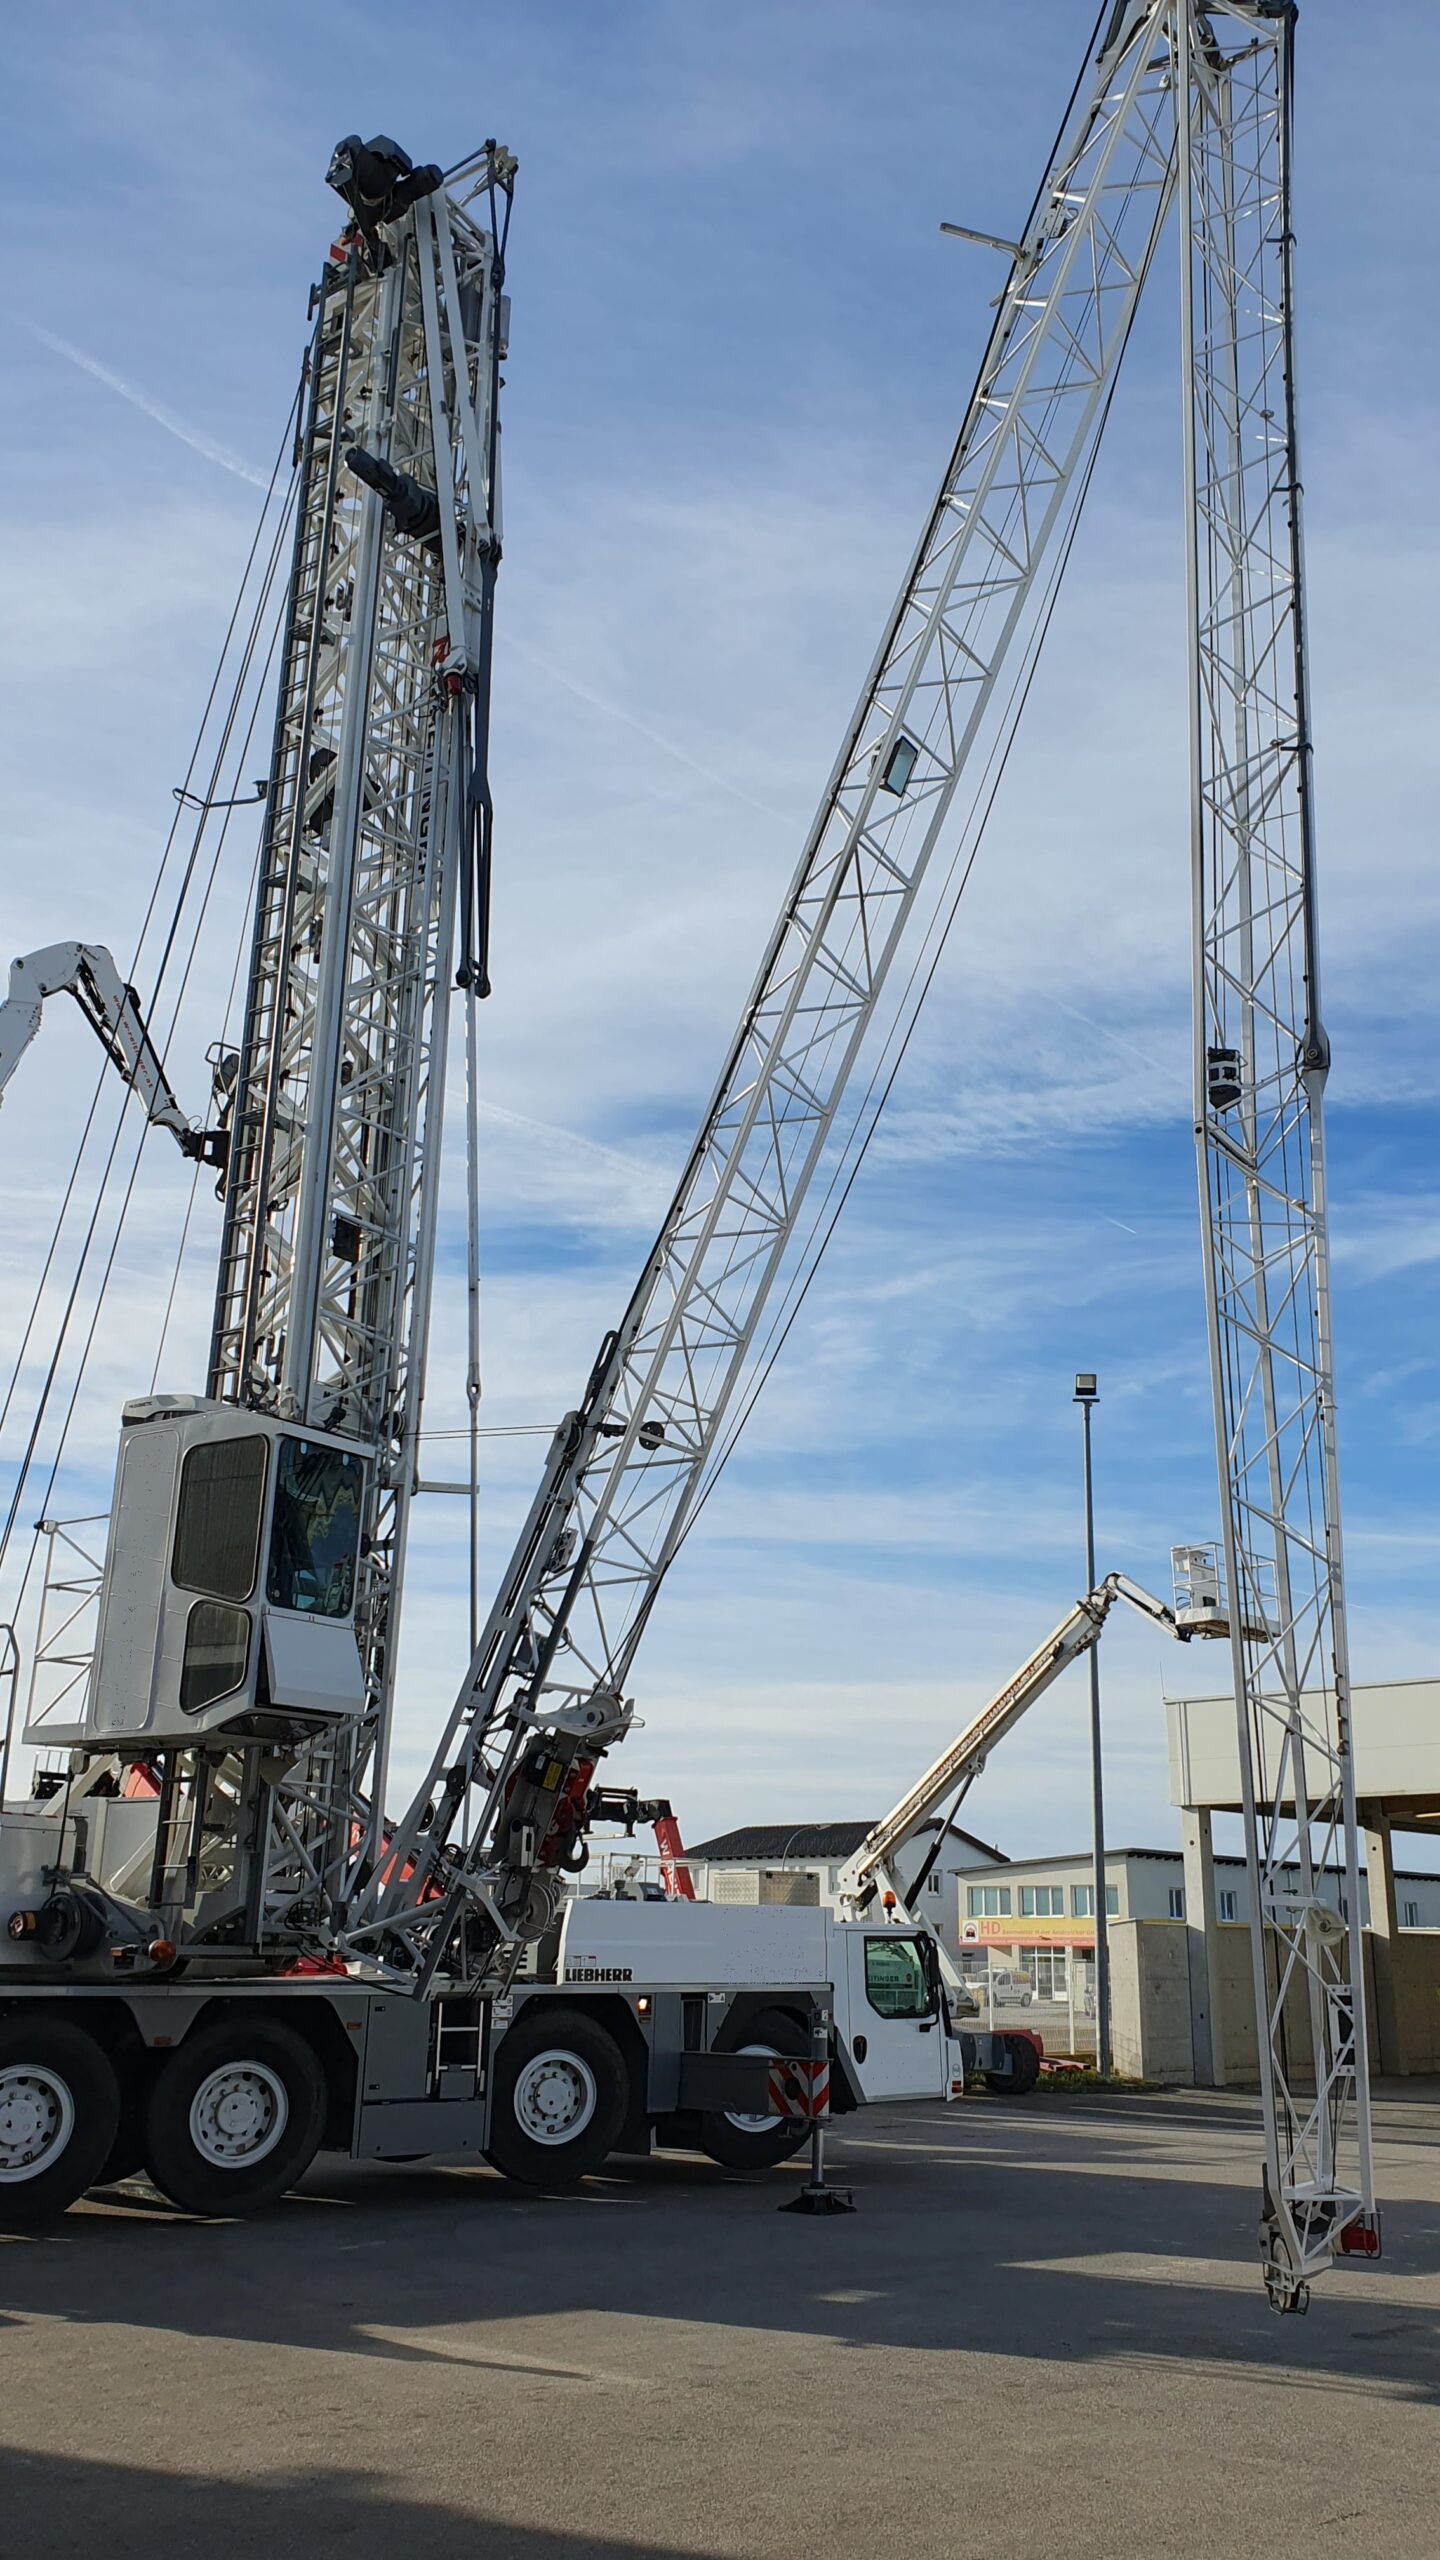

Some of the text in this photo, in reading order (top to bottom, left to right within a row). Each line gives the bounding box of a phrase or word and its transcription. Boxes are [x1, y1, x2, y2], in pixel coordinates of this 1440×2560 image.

[113, 995, 154, 1088] www.w-reitiger.at
[980, 1921, 1001, 1934] HD
[566, 1969, 632, 1982] LIEBHERR
